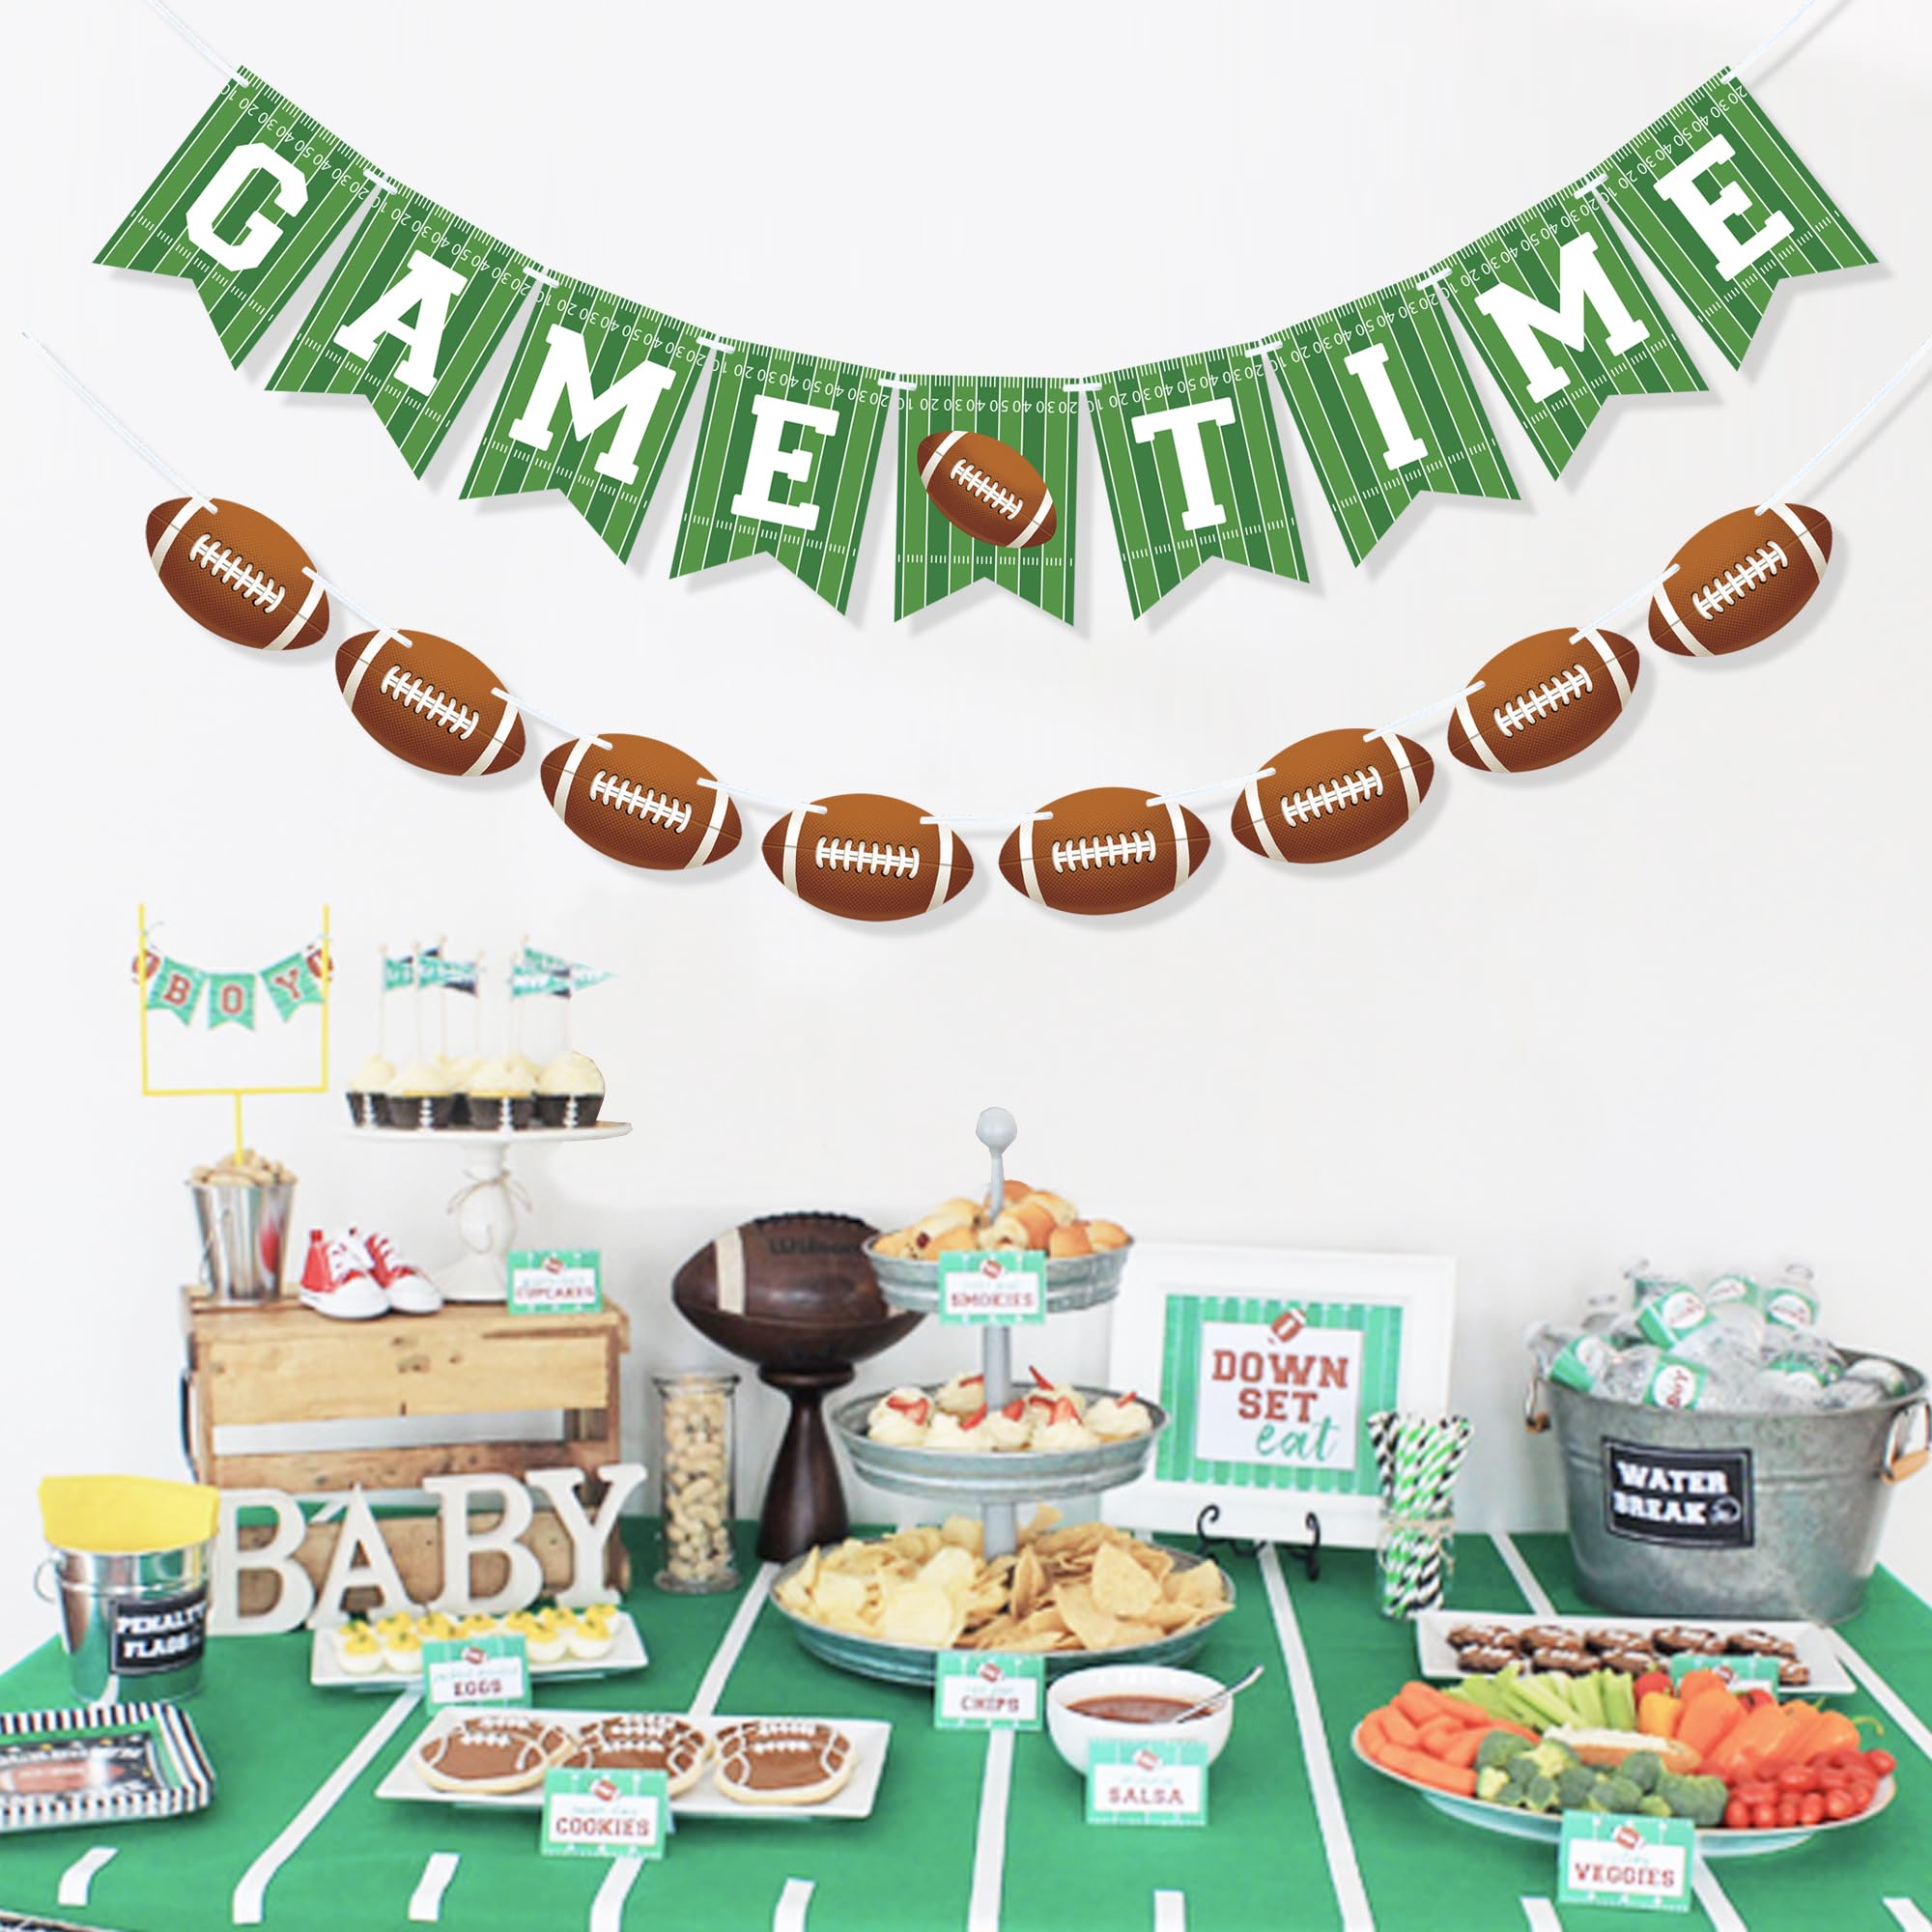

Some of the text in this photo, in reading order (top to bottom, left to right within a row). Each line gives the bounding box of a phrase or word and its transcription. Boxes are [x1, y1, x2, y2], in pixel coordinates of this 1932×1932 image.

[1728, 85, 1747, 103] 20
[240, 99, 258, 117] 20
[1711, 99, 1729, 117] 30
[258, 113, 277, 131] 30
[1691, 113, 1712, 131] 40
[276, 127, 296, 145] 40
[1674, 128, 1692, 145] 50
[295, 140, 314, 158] 50
[1656, 141, 1675, 159] 40
[313, 155, 332, 173] 40
[1637, 156, 1657, 174] 30
[331, 168, 351, 186] 30
[1619, 170, 1638, 188] 20
[350, 182, 369, 200] 20
[1580, 198, 1600, 215] 20
[391, 209, 411, 226] 20
[1561, 210, 1580, 227] 30
[412, 221, 431, 239] 30
[1541, 221, 1560, 239] 40
[432, 232, 451, 249] 40
[1520, 233, 1540, 250] 50
[452, 243, 470, 261] 50
[1501, 244, 1520, 262] 40
[471, 255, 492, 273] 40
[1482, 256, 1500, 273] 30
[492, 268, 511, 285] 30
[1461, 269, 1480, 286] 20
[511, 279, 530, 297] 20
[557, 299, 577, 316] 20
[1398, 301, 1418, 318] 30
[1419, 293, 1438, 309] 20
[580, 308, 599, 325] 30
[601, 317, 620, 333] 40
[1377, 310, 1397, 327] 40
[185, 133, 1795, 531] GAME TIME
[622, 326, 641, 341] 50
[1334, 327, 1353, 344] 40
[1355, 319, 1375, 335] 50
[643, 333, 664, 350] 40
[666, 342, 685, 358] 30
[1313, 336, 1332, 353] 30
[686, 351, 706, 366] 20
[1292, 346, 1311, 362] 20
[734, 364, 753, 379] 20
[757, 369, 777, 384] 30
[1200, 373, 1220, 387] 40
[1223, 368, 1242, 383] 30
[1245, 364, 1264, 379] 20
[780, 374, 799, 388] 40
[803, 379, 821, 393] 50
[1178, 378, 1197, 392] 50
[825, 384, 845, 398] 40
[848, 388, 867, 403] 30
[1132, 387, 1151, 402] 30
[1154, 383, 1174, 398] 40
[870, 393, 889, 407] 20
[921, 398, 939, 411] 20
[944, 399, 962, 411] 30
[967, 399, 985, 412] 40
[990, 400, 1009, 412] 50
[1012, 400, 1032, 412] 40
[1036, 401, 1055, 412] 30
[1059, 401, 1077, 413] 20
[1109, 392, 1128, 407] 20
[162, 968, 301, 1014] BOY
[951, 1292, 1034, 1307] SMOKIES
[1211, 1349, 1350, 1389] DOWN
[1237, 1387, 1319, 1423] SET
[1255, 1415, 1339, 1463] eat
[1616, 1460, 1728, 1494] WATER
[1612, 1491, 1707, 1525] BREAK
[207, 1463, 648, 1635] BABY
[453, 1679, 503, 1696] EGGS
[960, 1695, 1020, 1713] CHIPS
[1108, 1785, 1184, 1804] SALSA
[555, 1817, 650, 1837] COOKIES
[1575, 1861, 1675, 1889] VEGGIES
